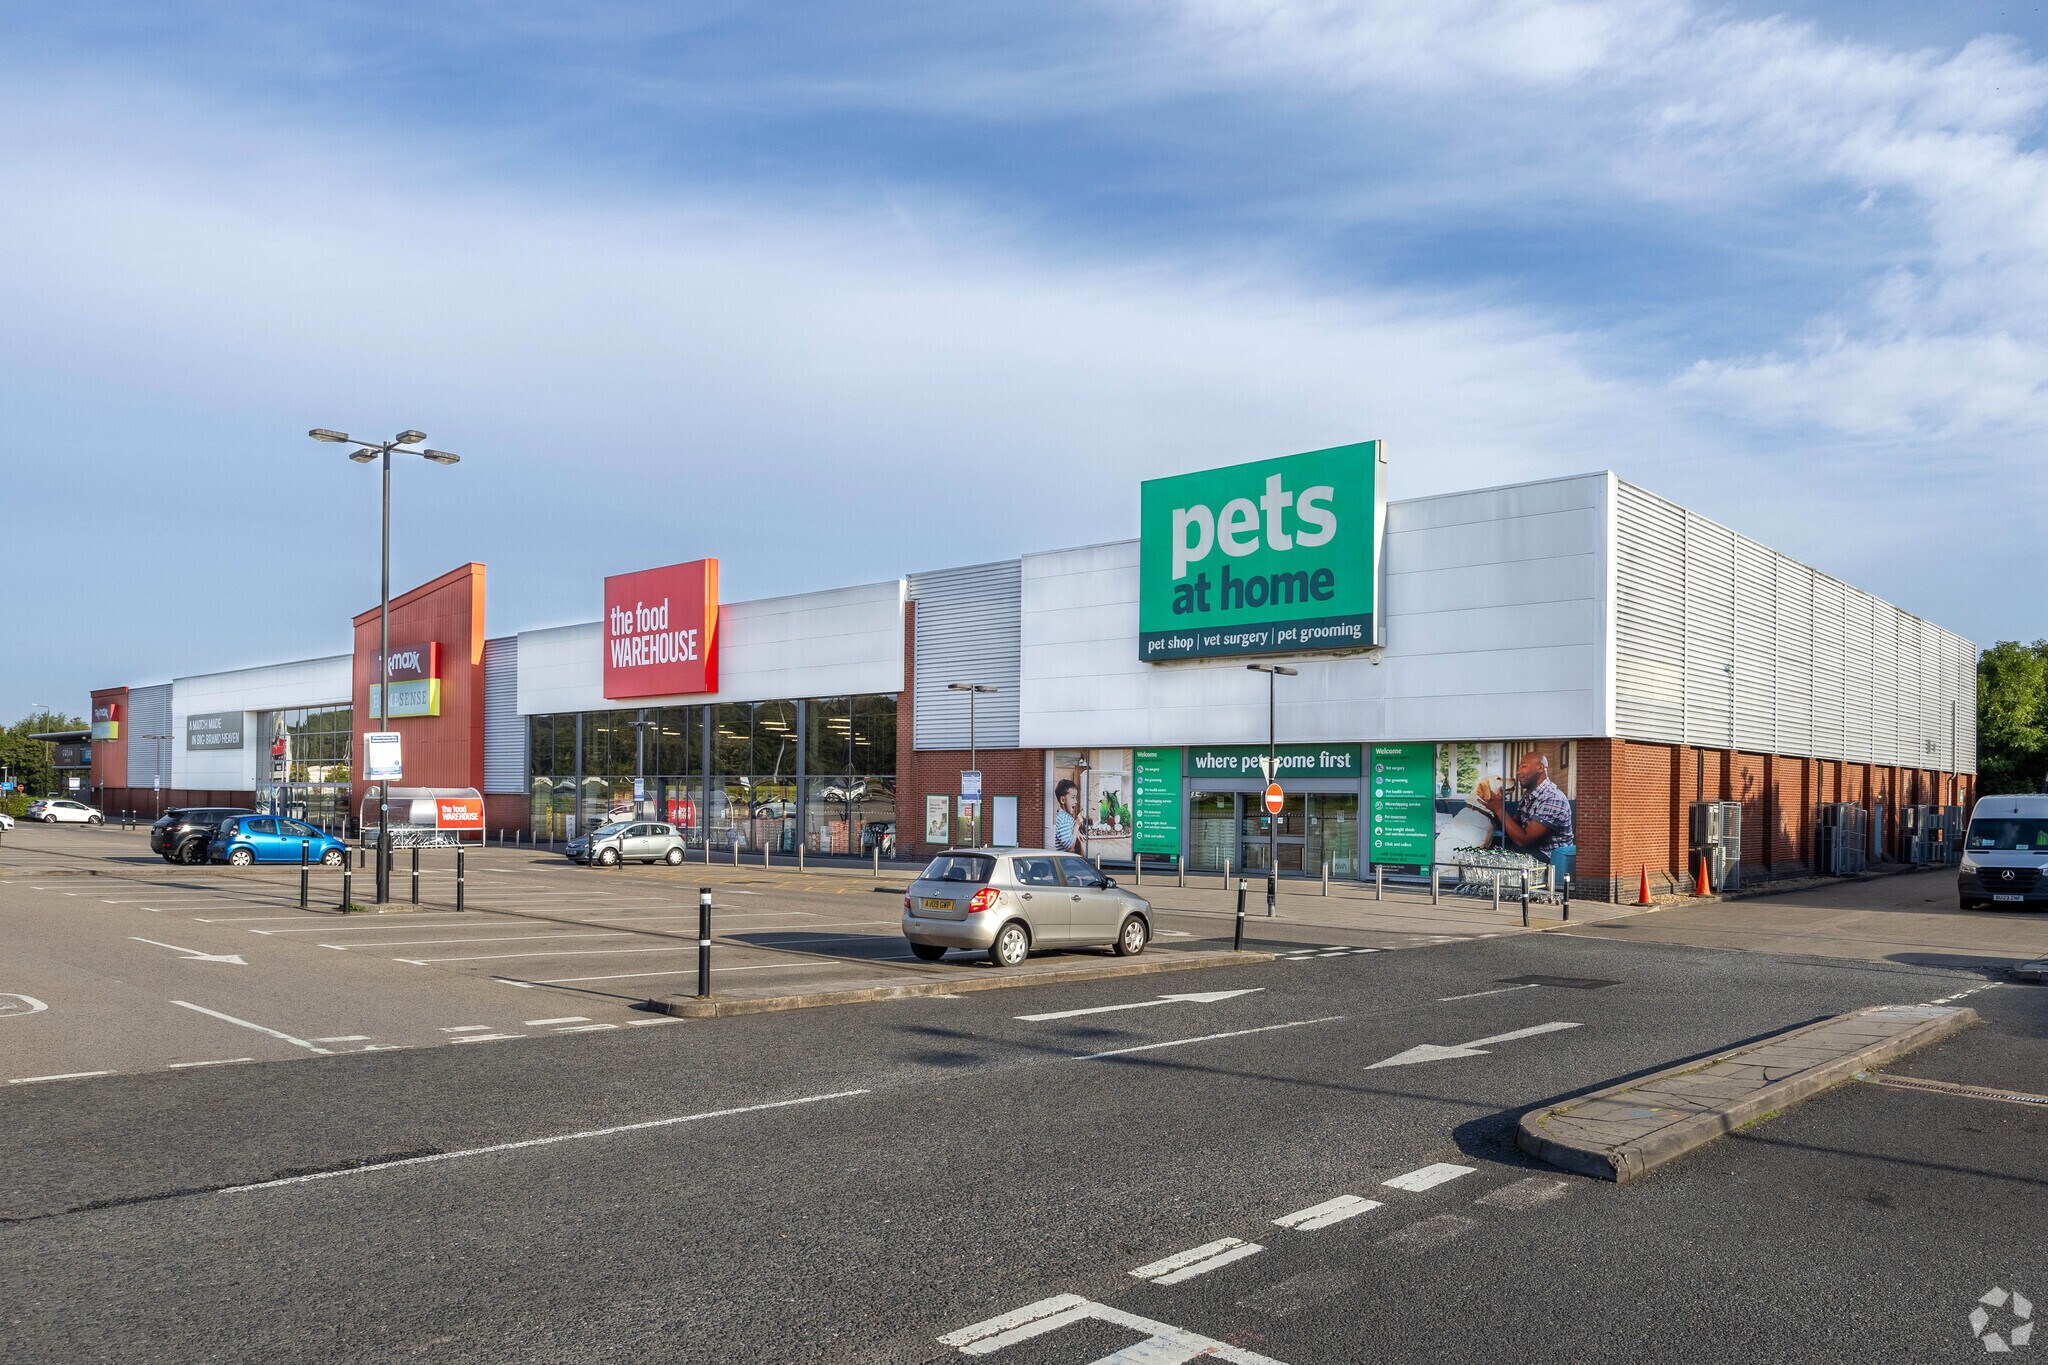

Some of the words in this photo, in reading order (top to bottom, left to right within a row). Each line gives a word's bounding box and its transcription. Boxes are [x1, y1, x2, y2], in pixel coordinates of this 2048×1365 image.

[1172, 472, 1337, 581] pets
[1172, 569, 1211, 615] at
[1221, 564, 1334, 611] home
[611, 605, 633, 636] the
[636, 598, 669, 632] food
[1204, 634, 1221, 646] vet
[1224, 632, 1268, 648] surgery
[1278, 627, 1297, 645] pet
[1300, 623, 1361, 643] grooming
[611, 629, 698, 668] WAREHOUSE
[1148, 639, 1165, 654] pet
[1168, 636, 1194, 651] shop
[373, 691, 427, 709] HMESENSE
[189, 720, 193, 731] A
[193, 719, 208, 731] MATCH
[209, 718, 222, 730] MADE
[192, 734, 196, 746] IN
[197, 734, 206, 745] BIG
[206, 733, 221, 745] BRAND
[222, 732, 240, 744] HEAVEN
[1195, 752, 1238, 769] where
[1241, 753, 1271, 773] pet
[1276, 755, 1315, 768] come
[1319, 750, 1351, 768] first
[441, 804, 452, 813] the
[452, 804, 467, 813] food
[442, 812, 479, 820] WAREHOUSE
